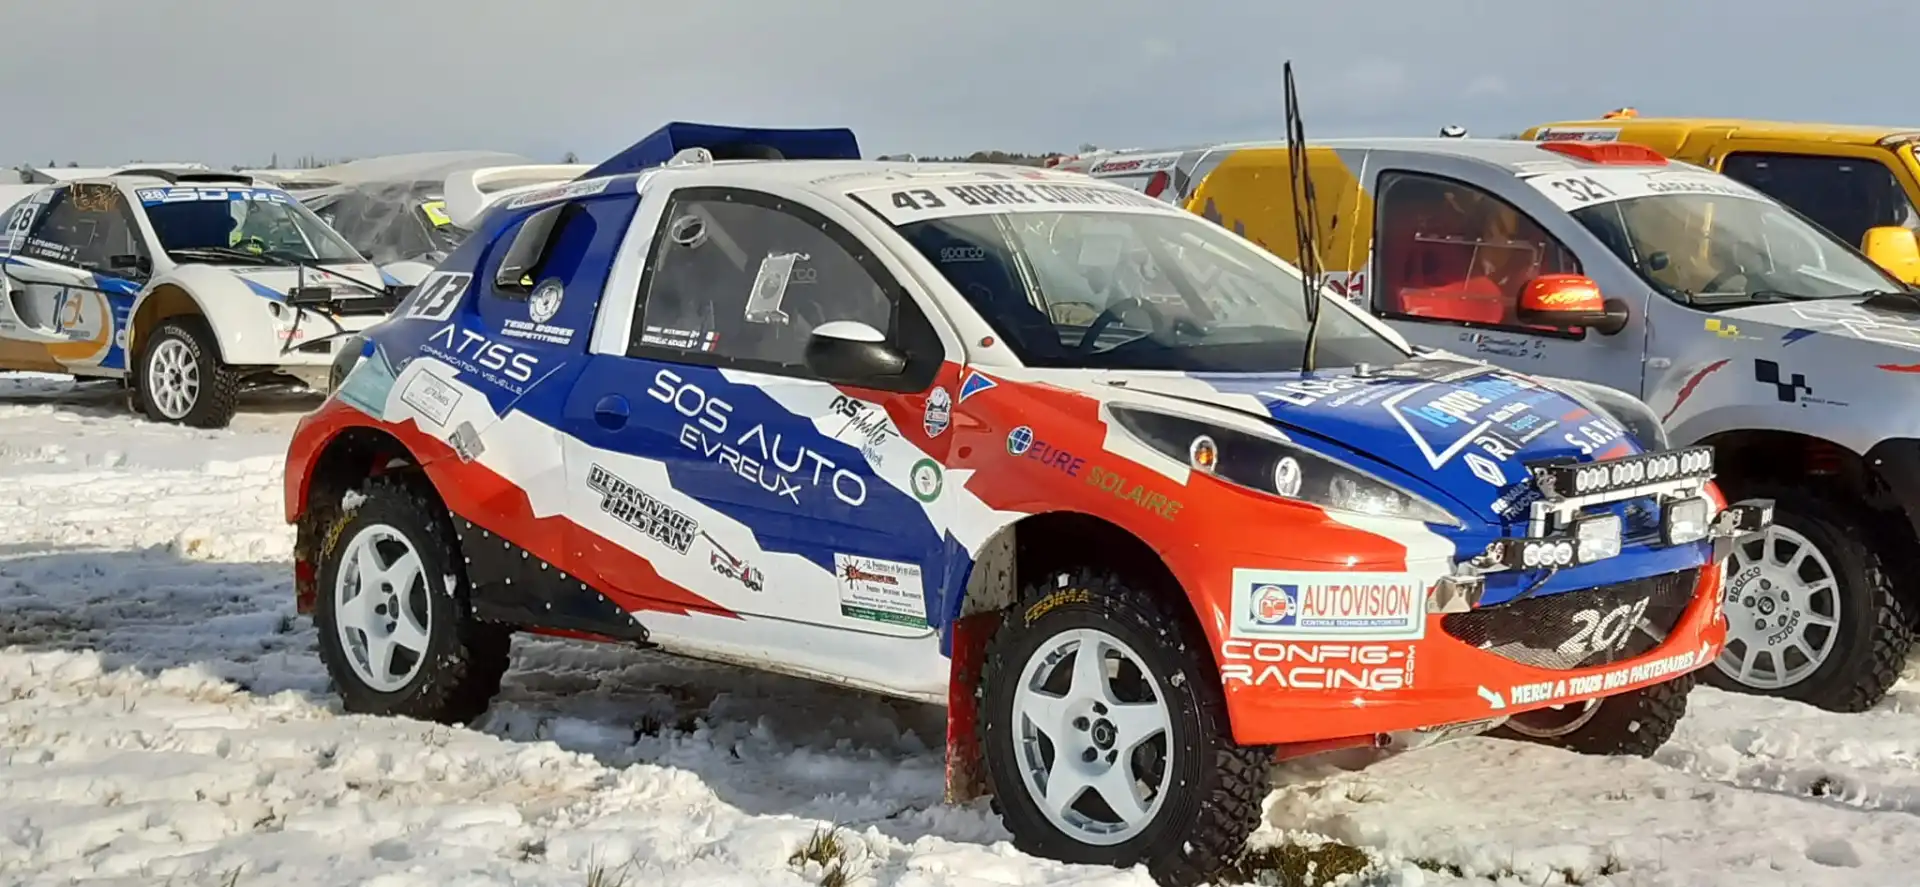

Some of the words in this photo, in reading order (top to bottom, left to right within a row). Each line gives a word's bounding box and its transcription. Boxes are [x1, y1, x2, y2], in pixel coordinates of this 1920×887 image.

[893, 190, 945, 210] 43
[946, 184, 1037, 206] BOREE
[1552, 176, 1617, 202] 321
[9, 208, 33, 231] 28
[940, 247, 985, 261] sparco
[411, 274, 465, 316] 43
[420, 344, 479, 375] COMMUNICATION
[481, 372, 524, 396] VISUELLE
[429, 324, 539, 382] ATISS
[647, 369, 733, 433] SOS
[738, 424, 867, 506] AUTO
[680, 423, 801, 504] EVREUX
[1029, 440, 1086, 477] EURE
[1086, 465, 1184, 522] SOLAIRE
[1502, 490, 1540, 521] TRUCKS
[600, 493, 697, 556] TRISTAN
[1302, 584, 1413, 616] AUTOVISION
[1728, 566, 1761, 603] sparco
[1556, 596, 1650, 654] 207
[1768, 610, 1801, 647] sparco
[1221, 640, 1405, 665] CONFIG-
[1221, 664, 1405, 690] RACING
[1511, 685, 1551, 705] MERCI
[1554, 680, 1566, 698] A
[1568, 674, 1603, 696] TOUS
[1604, 669, 1629, 690] NOS
[1629, 652, 1696, 683] PARTENAIRES
